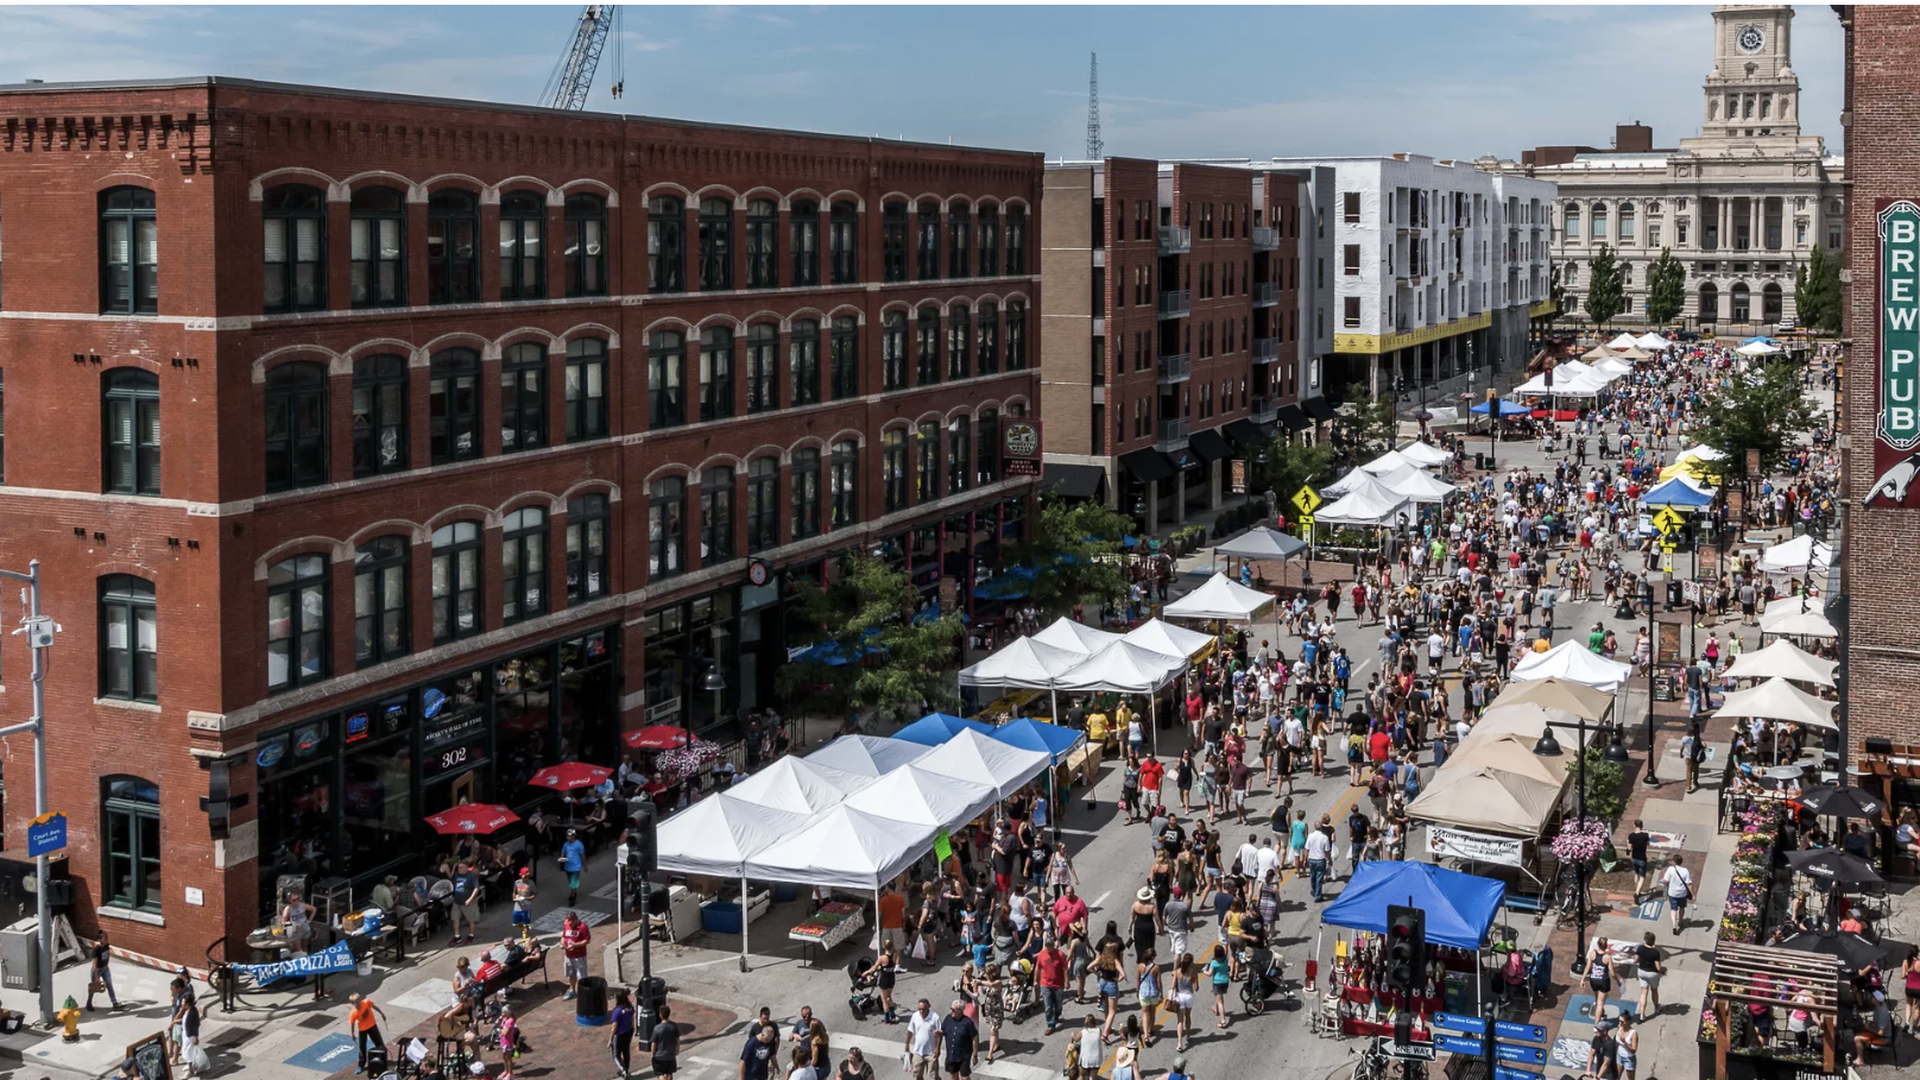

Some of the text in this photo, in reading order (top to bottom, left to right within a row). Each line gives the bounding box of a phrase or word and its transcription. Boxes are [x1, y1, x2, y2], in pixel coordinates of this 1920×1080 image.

[1888, 220, 1918, 430] BREW PUB
[442, 747, 467, 768] 302
[33, 832, 49, 841] Court
[301, 954, 331, 970] PIZZA
[1446, 1038, 1468, 1047] Principal
[1414, 1046, 1430, 1056] WAY
